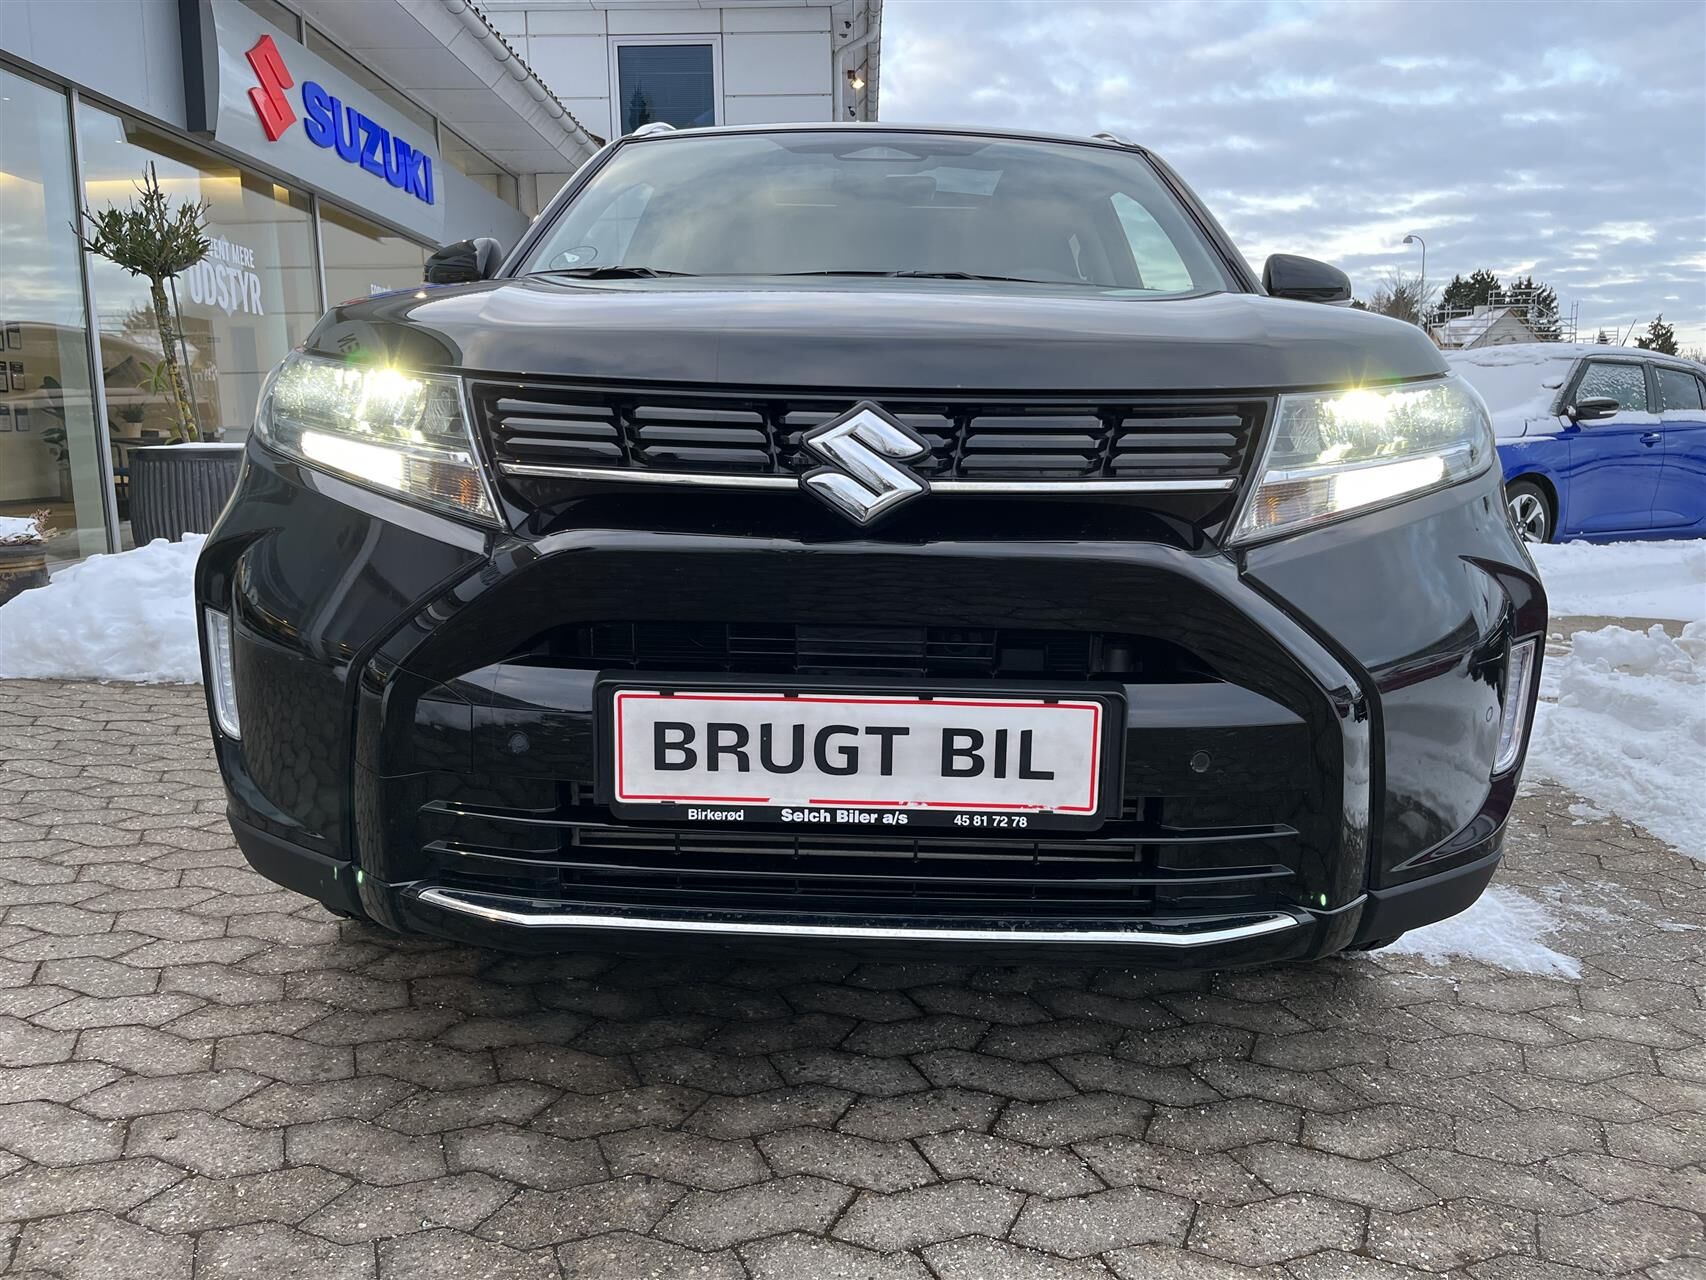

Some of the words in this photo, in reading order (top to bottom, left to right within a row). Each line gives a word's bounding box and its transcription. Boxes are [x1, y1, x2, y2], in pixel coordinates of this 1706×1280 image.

[302, 81, 434, 205] SUZUKI
[231, 243, 255, 269] MERE
[189, 259, 264, 316] UDSTYR
[654, 721, 910, 776] BRUGT
[941, 727, 1055, 781] BIL
[688, 808, 745, 821] Birkerød
[781, 808, 831, 823] Selch
[836, 810, 878, 824] Biler
[882, 811, 909, 825] a/s
[954, 814, 970, 826] 45
[973, 815, 988, 827] 81
[992, 815, 1008, 827] 72
[1011, 816, 1028, 828] 78
